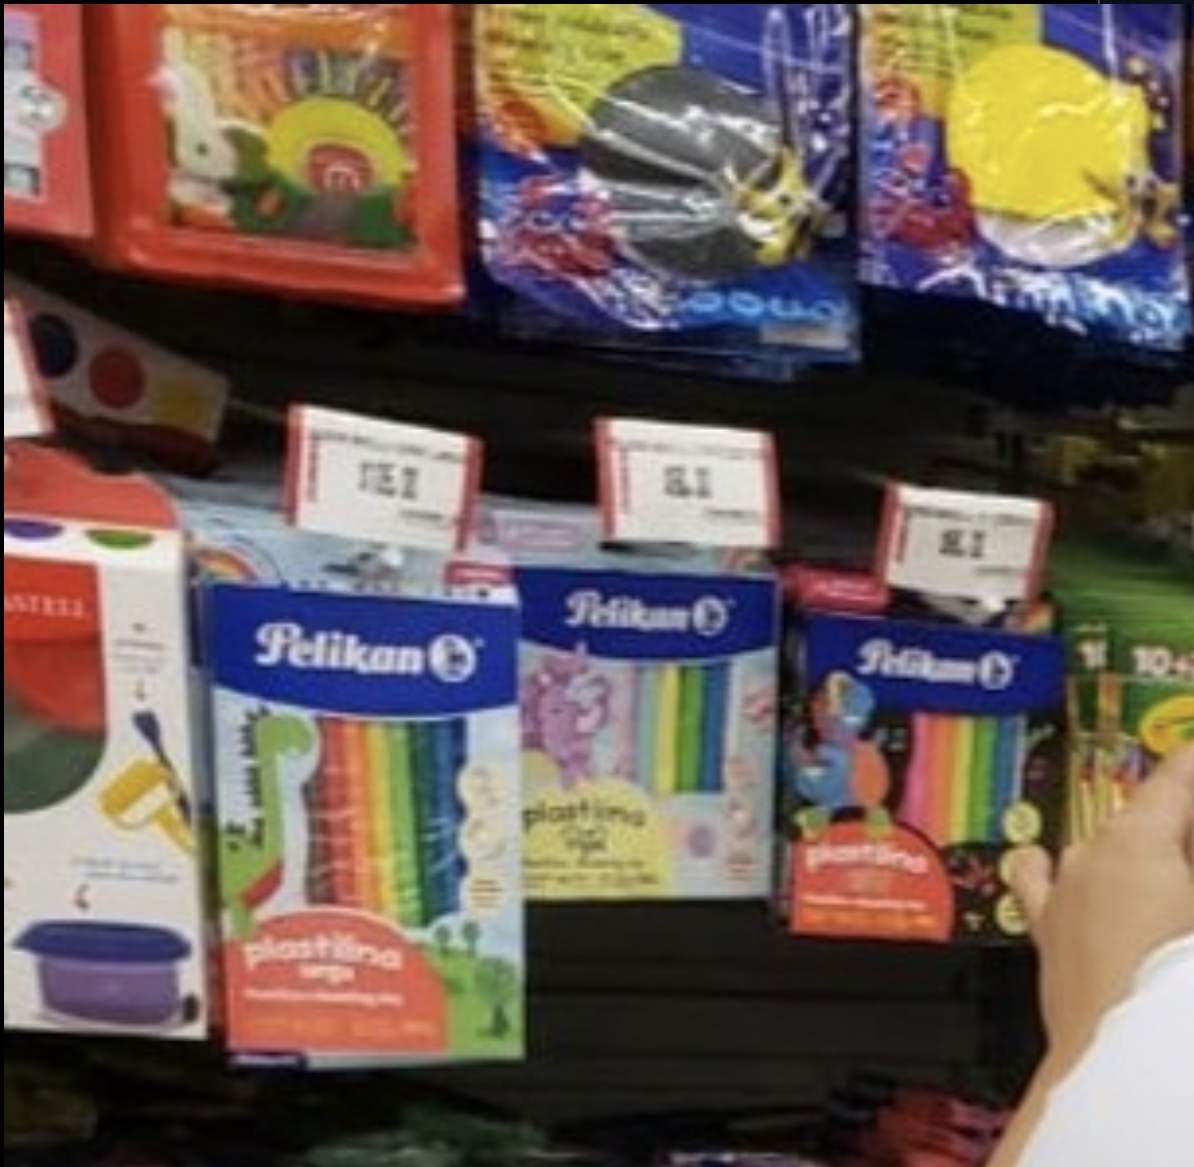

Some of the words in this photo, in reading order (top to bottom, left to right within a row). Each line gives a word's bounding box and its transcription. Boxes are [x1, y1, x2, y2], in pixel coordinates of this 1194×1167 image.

[564, 588, 690, 632] Pelikan
[255, 621, 424, 676] Pelikan
[856, 638, 978, 684] Pelikan
[244, 932, 405, 971] plastilina
